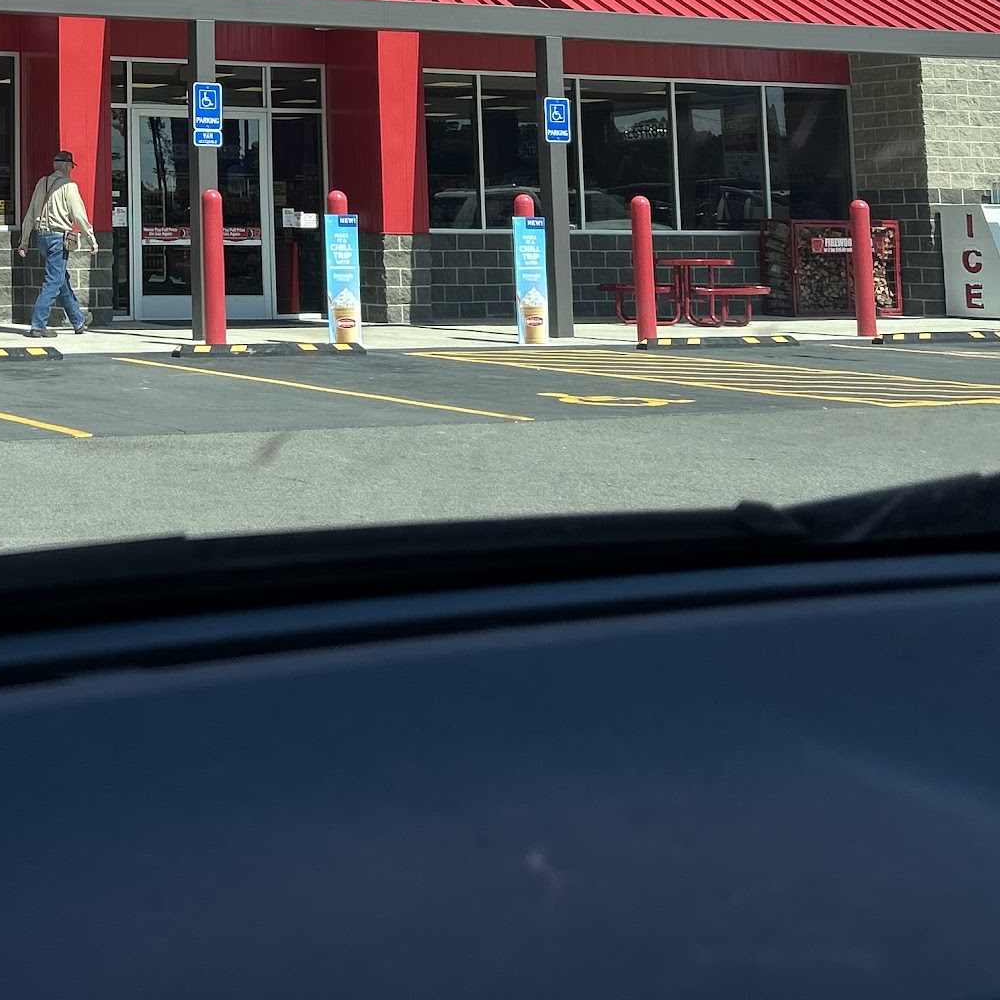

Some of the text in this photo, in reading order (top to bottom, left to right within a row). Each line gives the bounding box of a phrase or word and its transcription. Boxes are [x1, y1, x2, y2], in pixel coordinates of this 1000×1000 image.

[196, 117, 220, 125] PARKING
[547, 129, 569, 137] PARKING
[825, 238, 853, 247] FIREWOO
[962, 210, 984, 309] ICE
